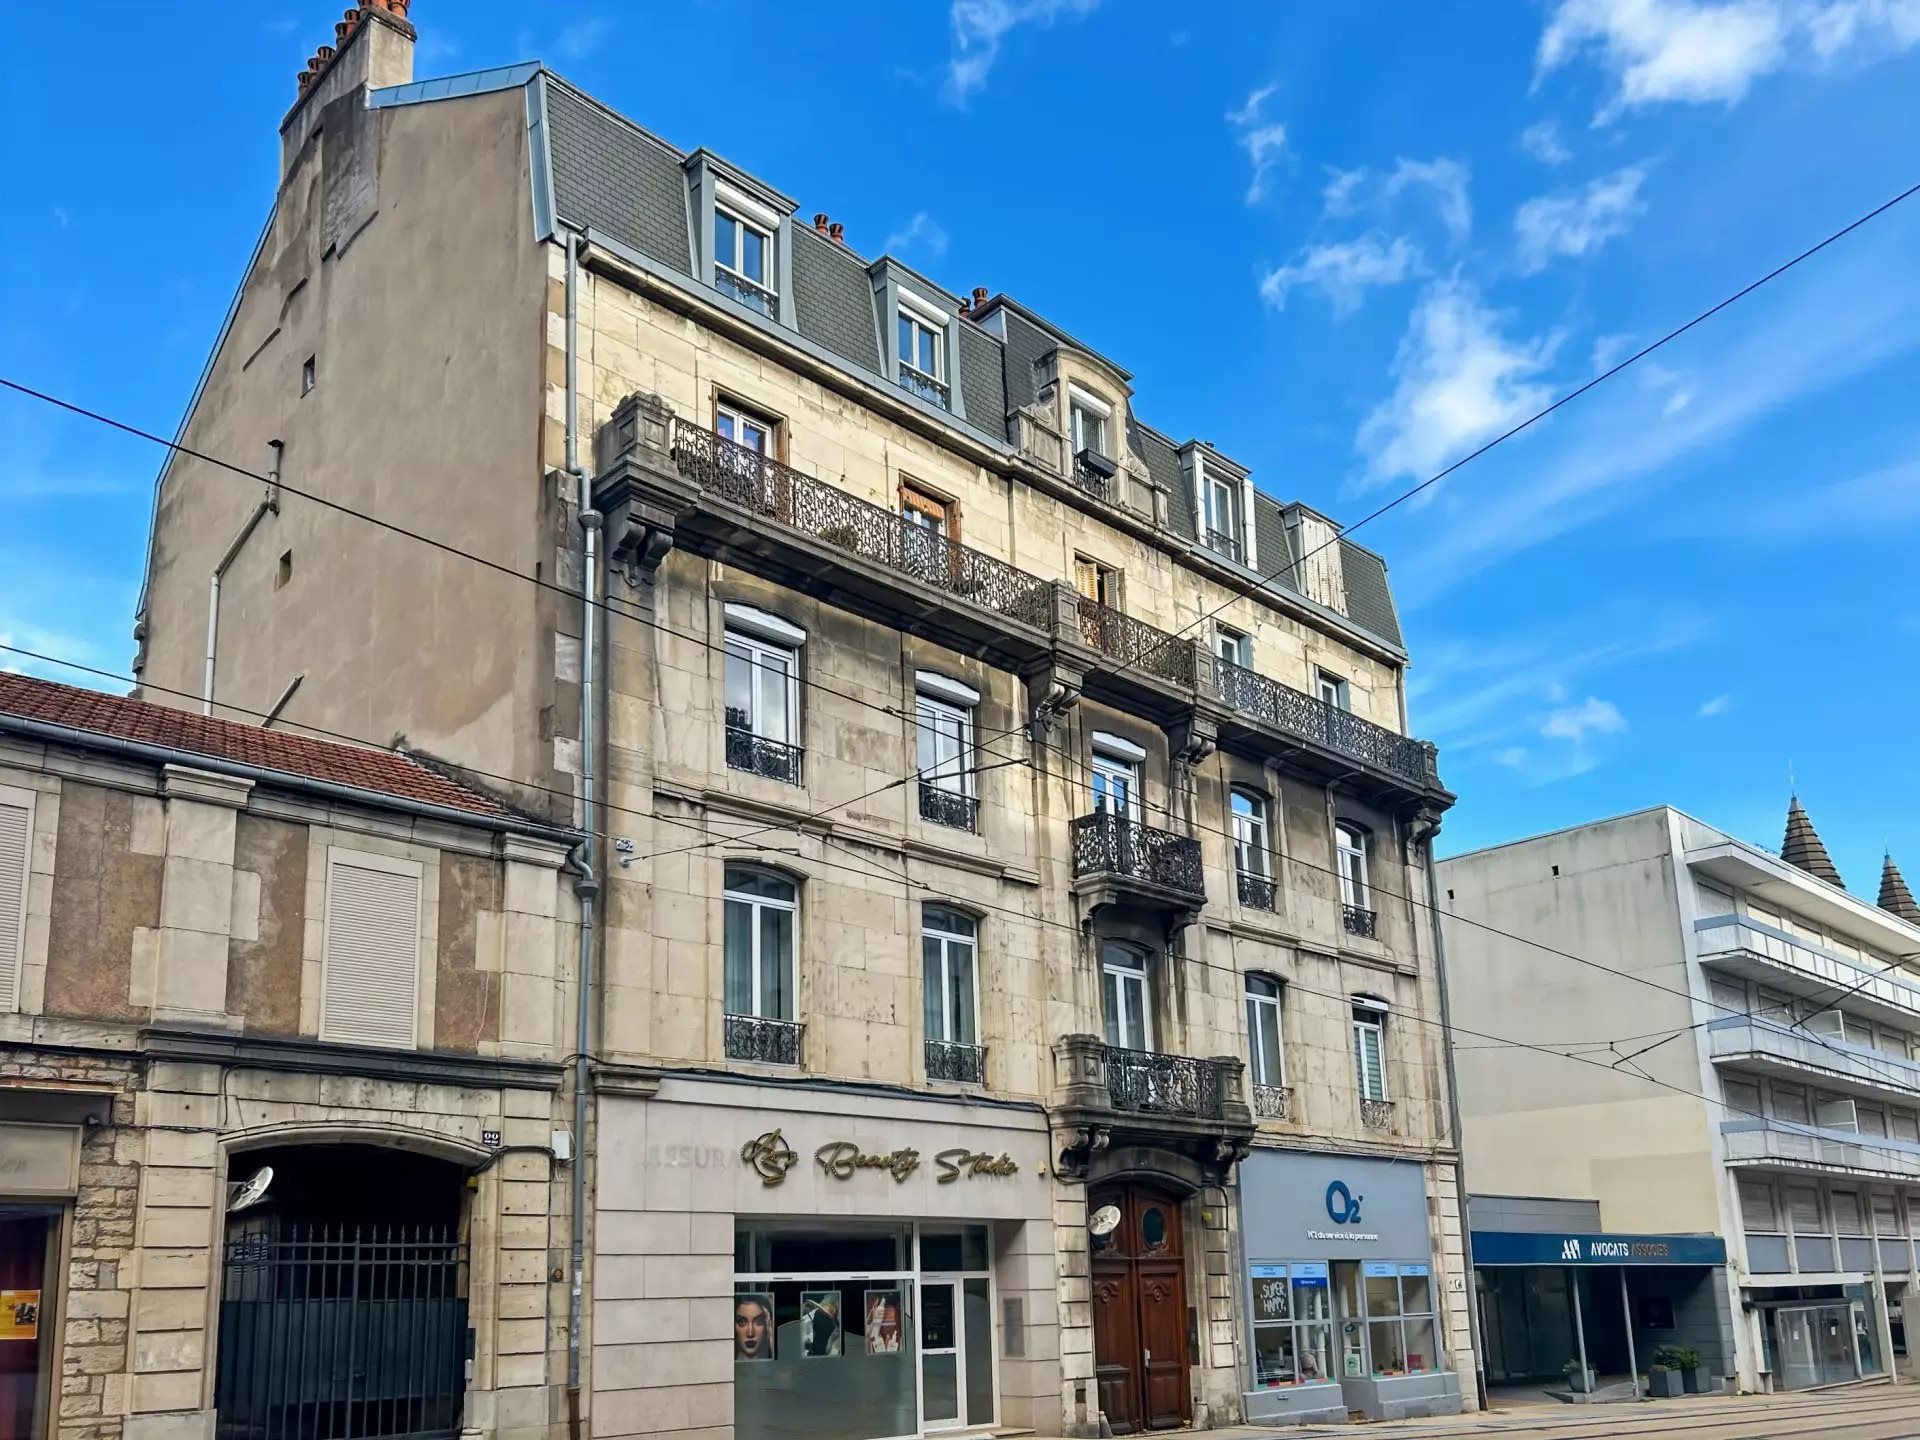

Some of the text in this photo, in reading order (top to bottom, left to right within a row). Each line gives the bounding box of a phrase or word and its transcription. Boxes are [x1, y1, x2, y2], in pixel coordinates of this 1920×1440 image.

[814, 1141, 1018, 1184] Beauty Studio
[1591, 1242, 1629, 1257] AVOCATS
